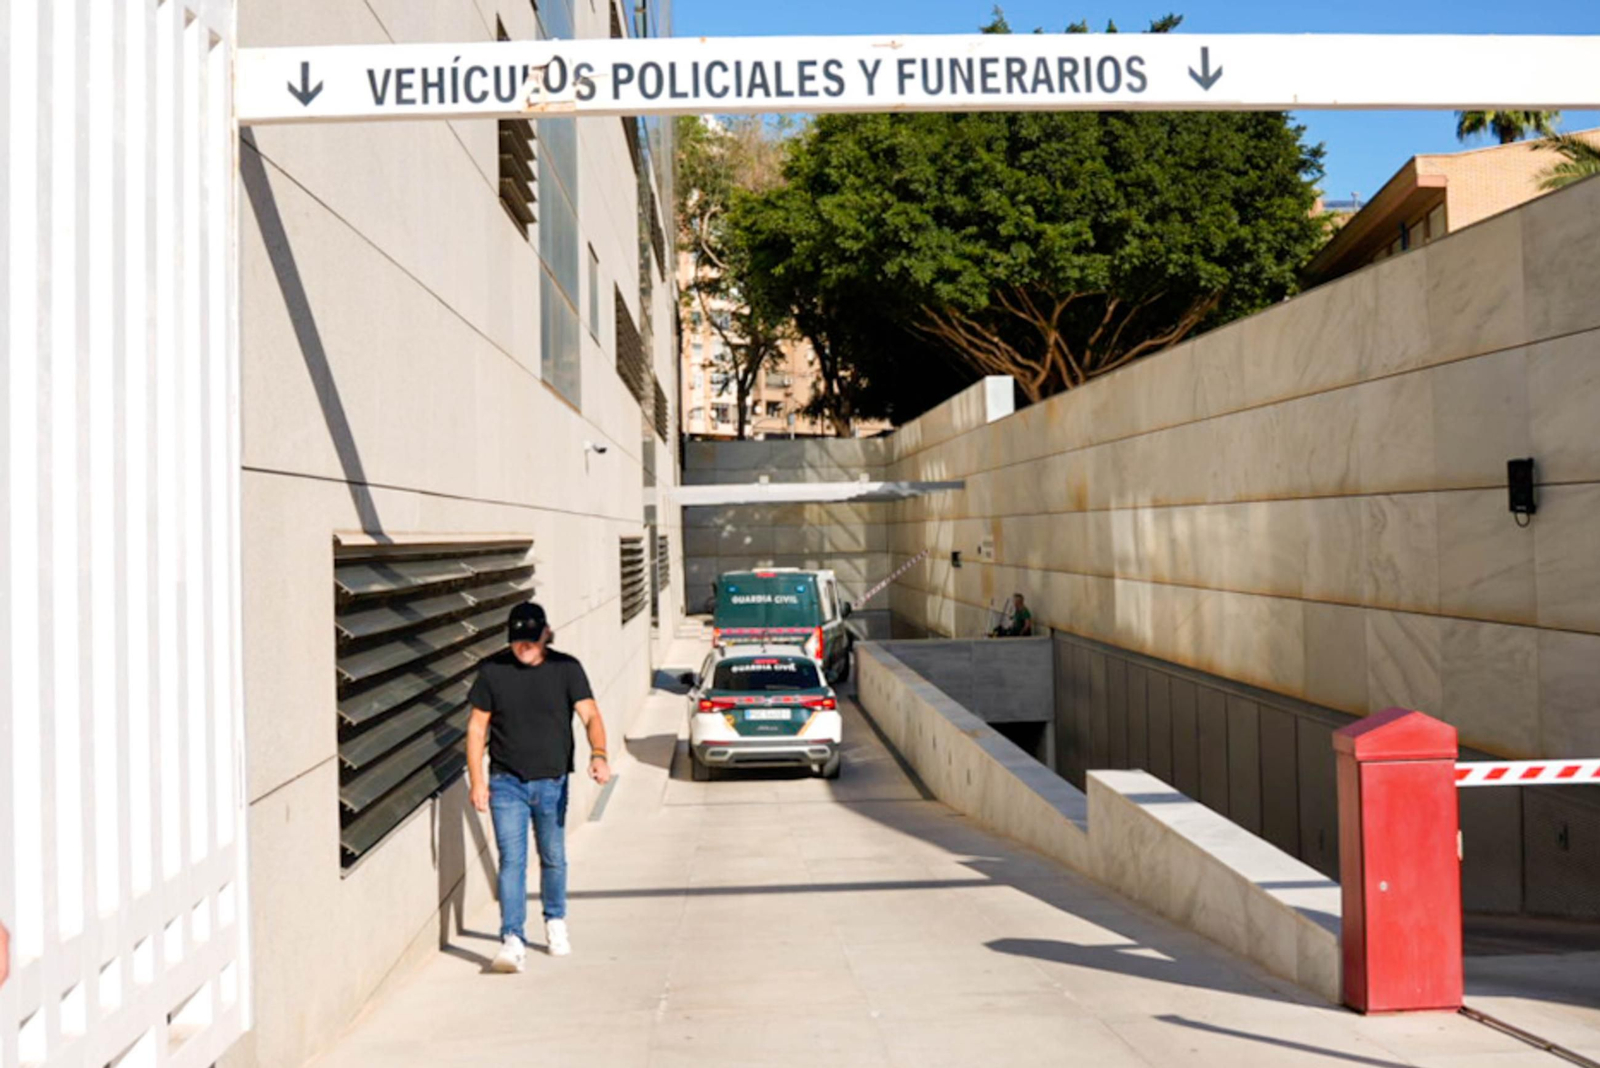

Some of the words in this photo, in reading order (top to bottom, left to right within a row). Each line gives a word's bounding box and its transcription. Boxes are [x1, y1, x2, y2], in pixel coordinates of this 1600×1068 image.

[612, 60, 845, 100] POLICIALES
[858, 59, 882, 95] Y
[897, 55, 1148, 95] FUNERARIOS
[731, 595, 772, 604] GUARDIA
[774, 595, 798, 604] CIVIL
[731, 664, 772, 673] GUARDIA
